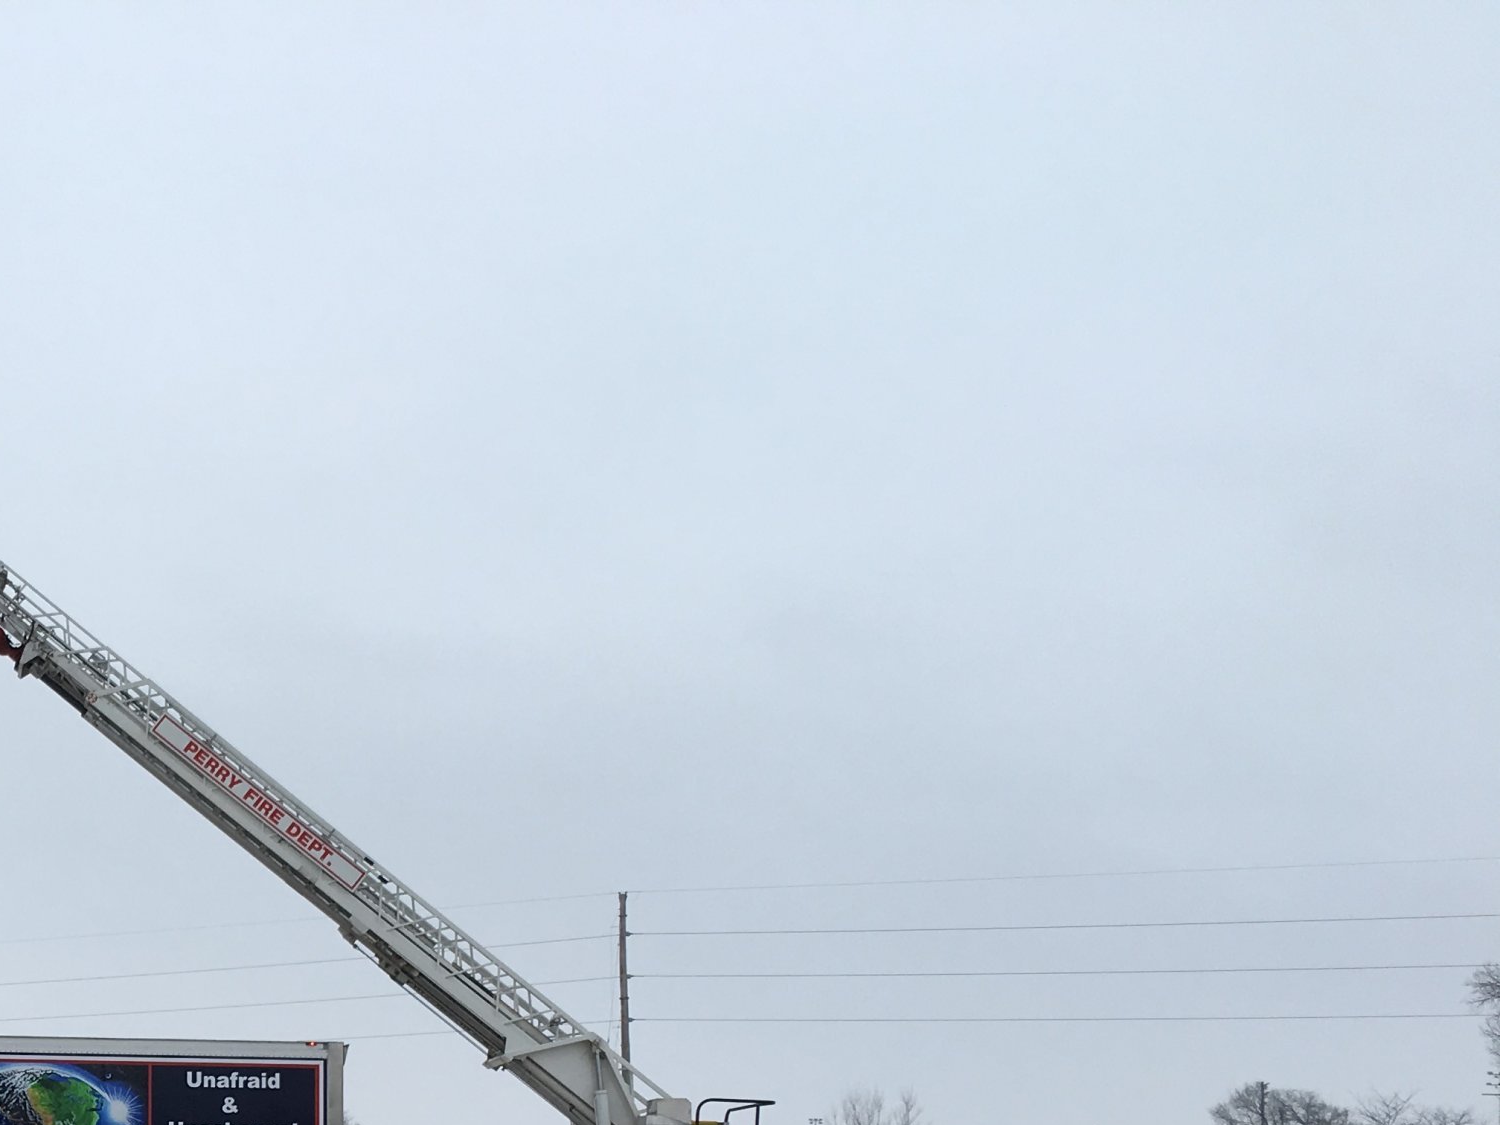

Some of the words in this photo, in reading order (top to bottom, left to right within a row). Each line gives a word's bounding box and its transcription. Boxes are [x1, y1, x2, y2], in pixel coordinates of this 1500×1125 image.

[183, 740, 243, 789] PERRY
[242, 788, 286, 825] FIRE
[285, 821, 334, 867] DEPT.
[186, 1071, 280, 1089] Unafraid
[221, 1096, 239, 1114] &
